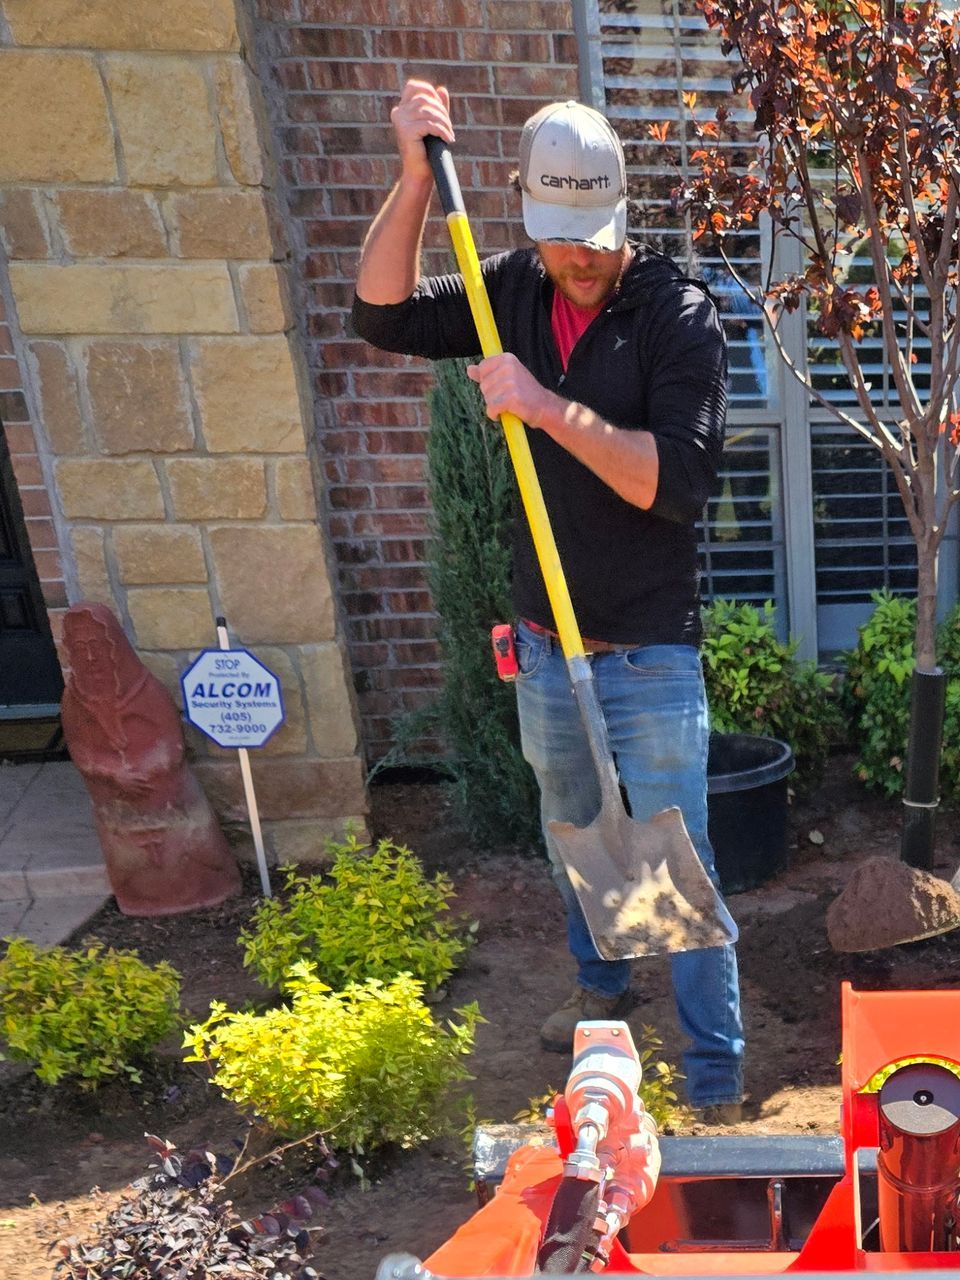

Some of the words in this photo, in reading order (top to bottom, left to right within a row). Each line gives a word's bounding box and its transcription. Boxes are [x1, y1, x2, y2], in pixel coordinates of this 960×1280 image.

[540, 174, 609, 190] carhartt
[215, 659, 240, 670] STOP
[191, 683, 272, 698] ALCOM
[191, 700, 232, 709] Security
[236, 700, 277, 709] Systems
[221, 712, 251, 723] (405)
[209, 724, 267, 733] 732-9000
